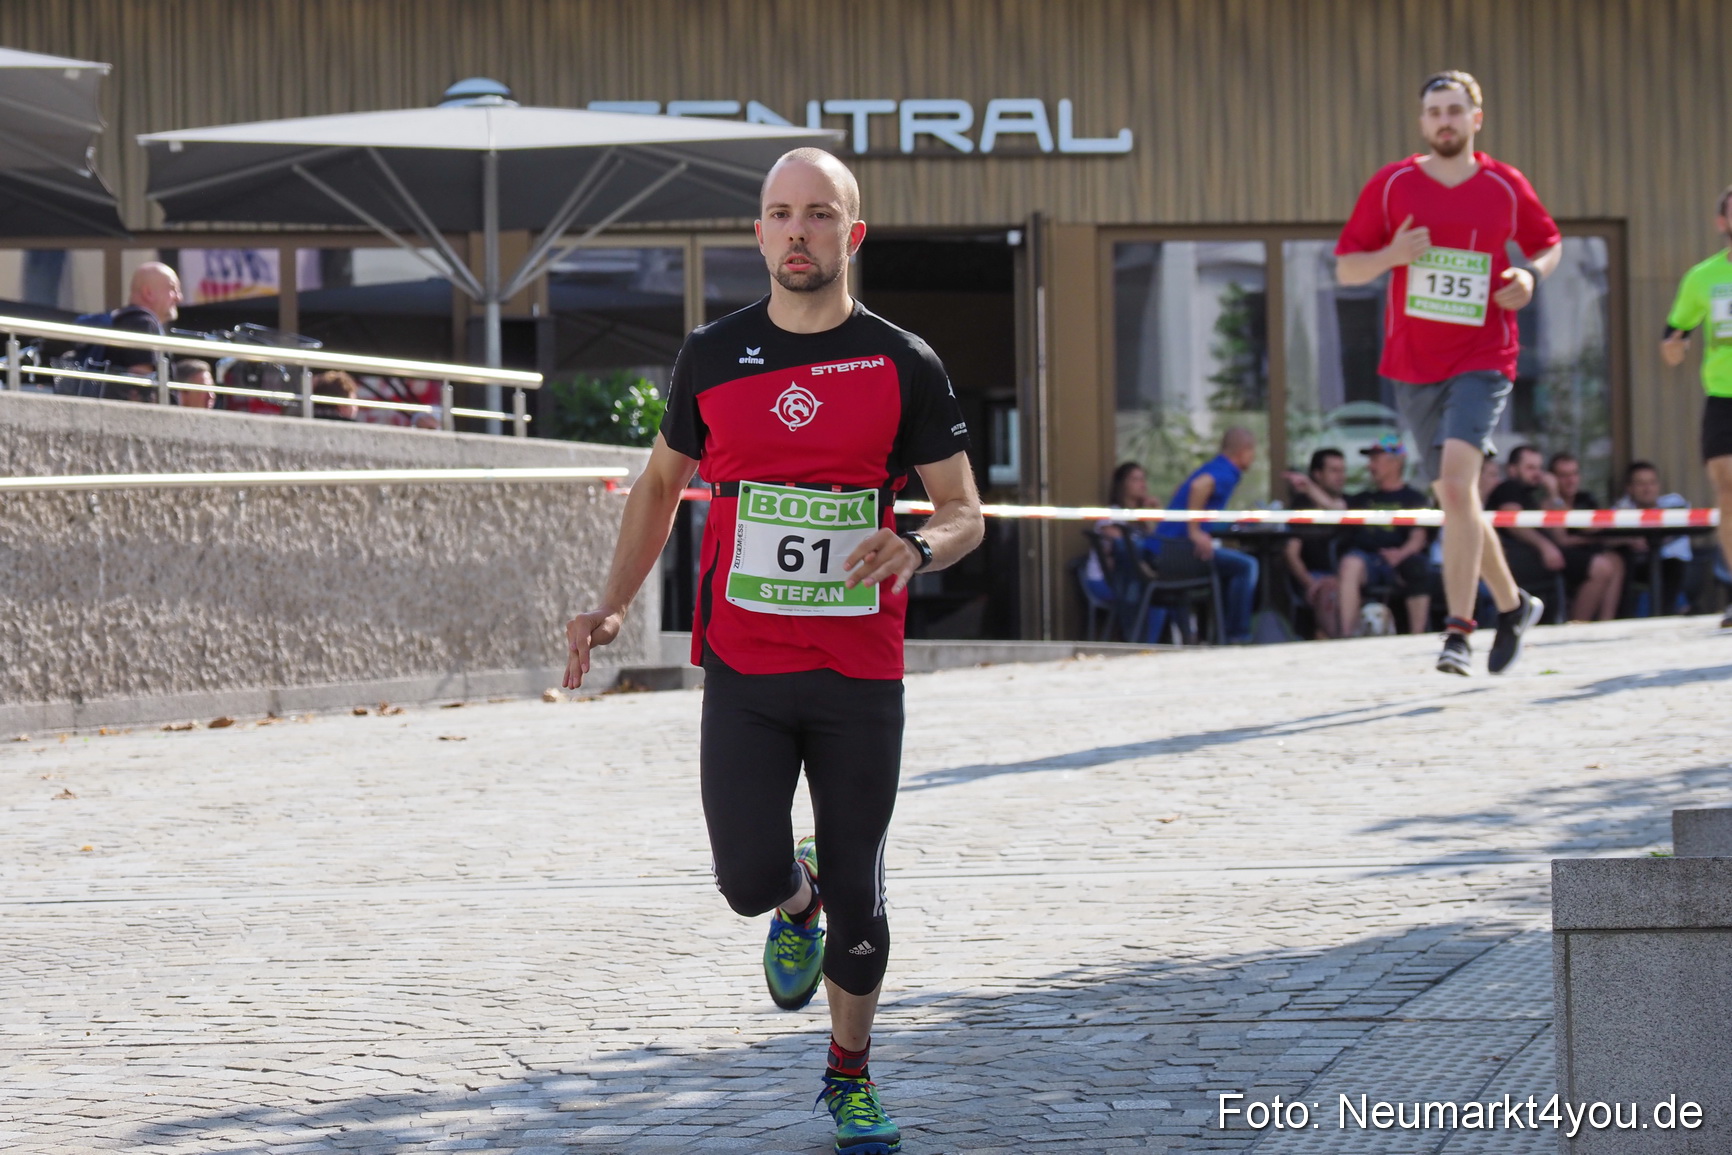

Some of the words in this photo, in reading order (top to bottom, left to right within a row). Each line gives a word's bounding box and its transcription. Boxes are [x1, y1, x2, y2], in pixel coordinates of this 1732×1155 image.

[1426, 273, 1473, 298] 135
[738, 356, 765, 365] erima
[811, 357, 885, 376] STEFAN
[747, 488, 868, 526] BOCK
[777, 534, 831, 574] 61
[759, 583, 845, 603] STEFAN
